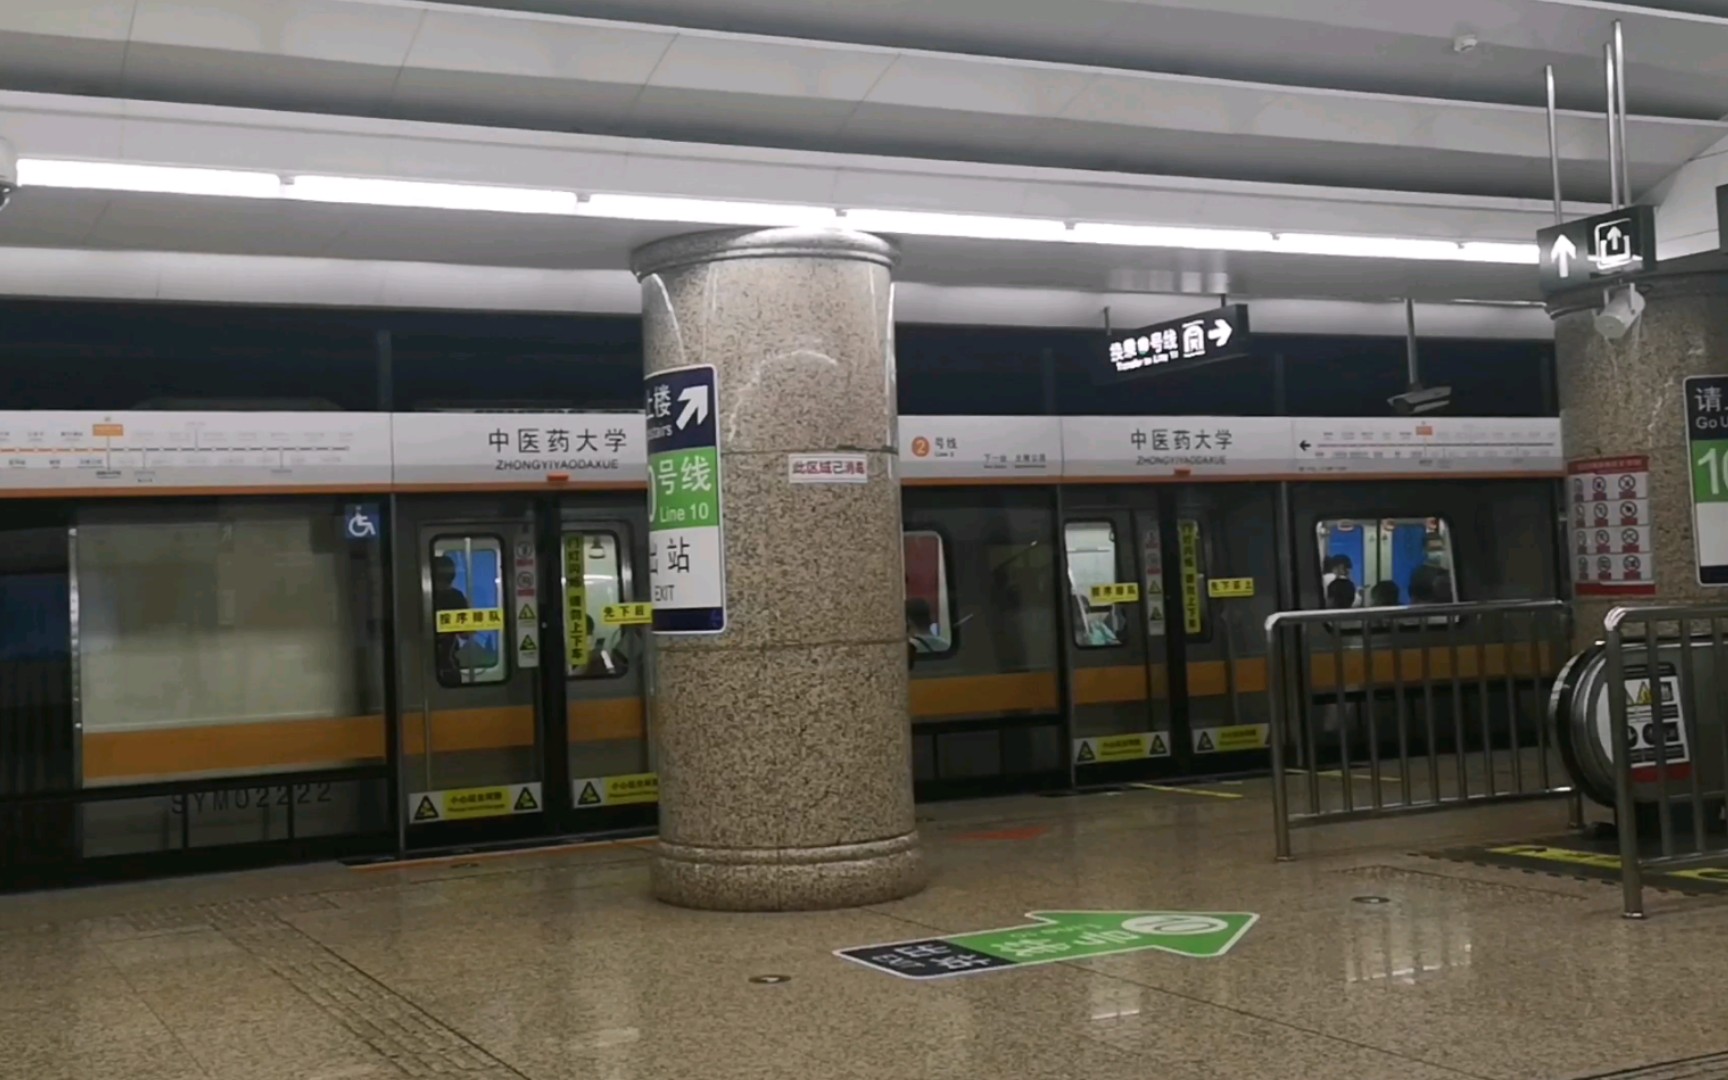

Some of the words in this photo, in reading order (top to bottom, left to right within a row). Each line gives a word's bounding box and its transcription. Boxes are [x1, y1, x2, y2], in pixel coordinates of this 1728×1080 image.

[1694, 386, 1728, 412] 请
[1696, 416, 1718, 429] Go
[488, 428, 627, 453] 中医药大学
[1131, 428, 1232, 450] 中医药大学
[658, 456, 712, 496] 号线
[660, 505, 685, 524] Line
[690, 502, 709, 521] 10
[655, 585, 675, 602] EXIT
